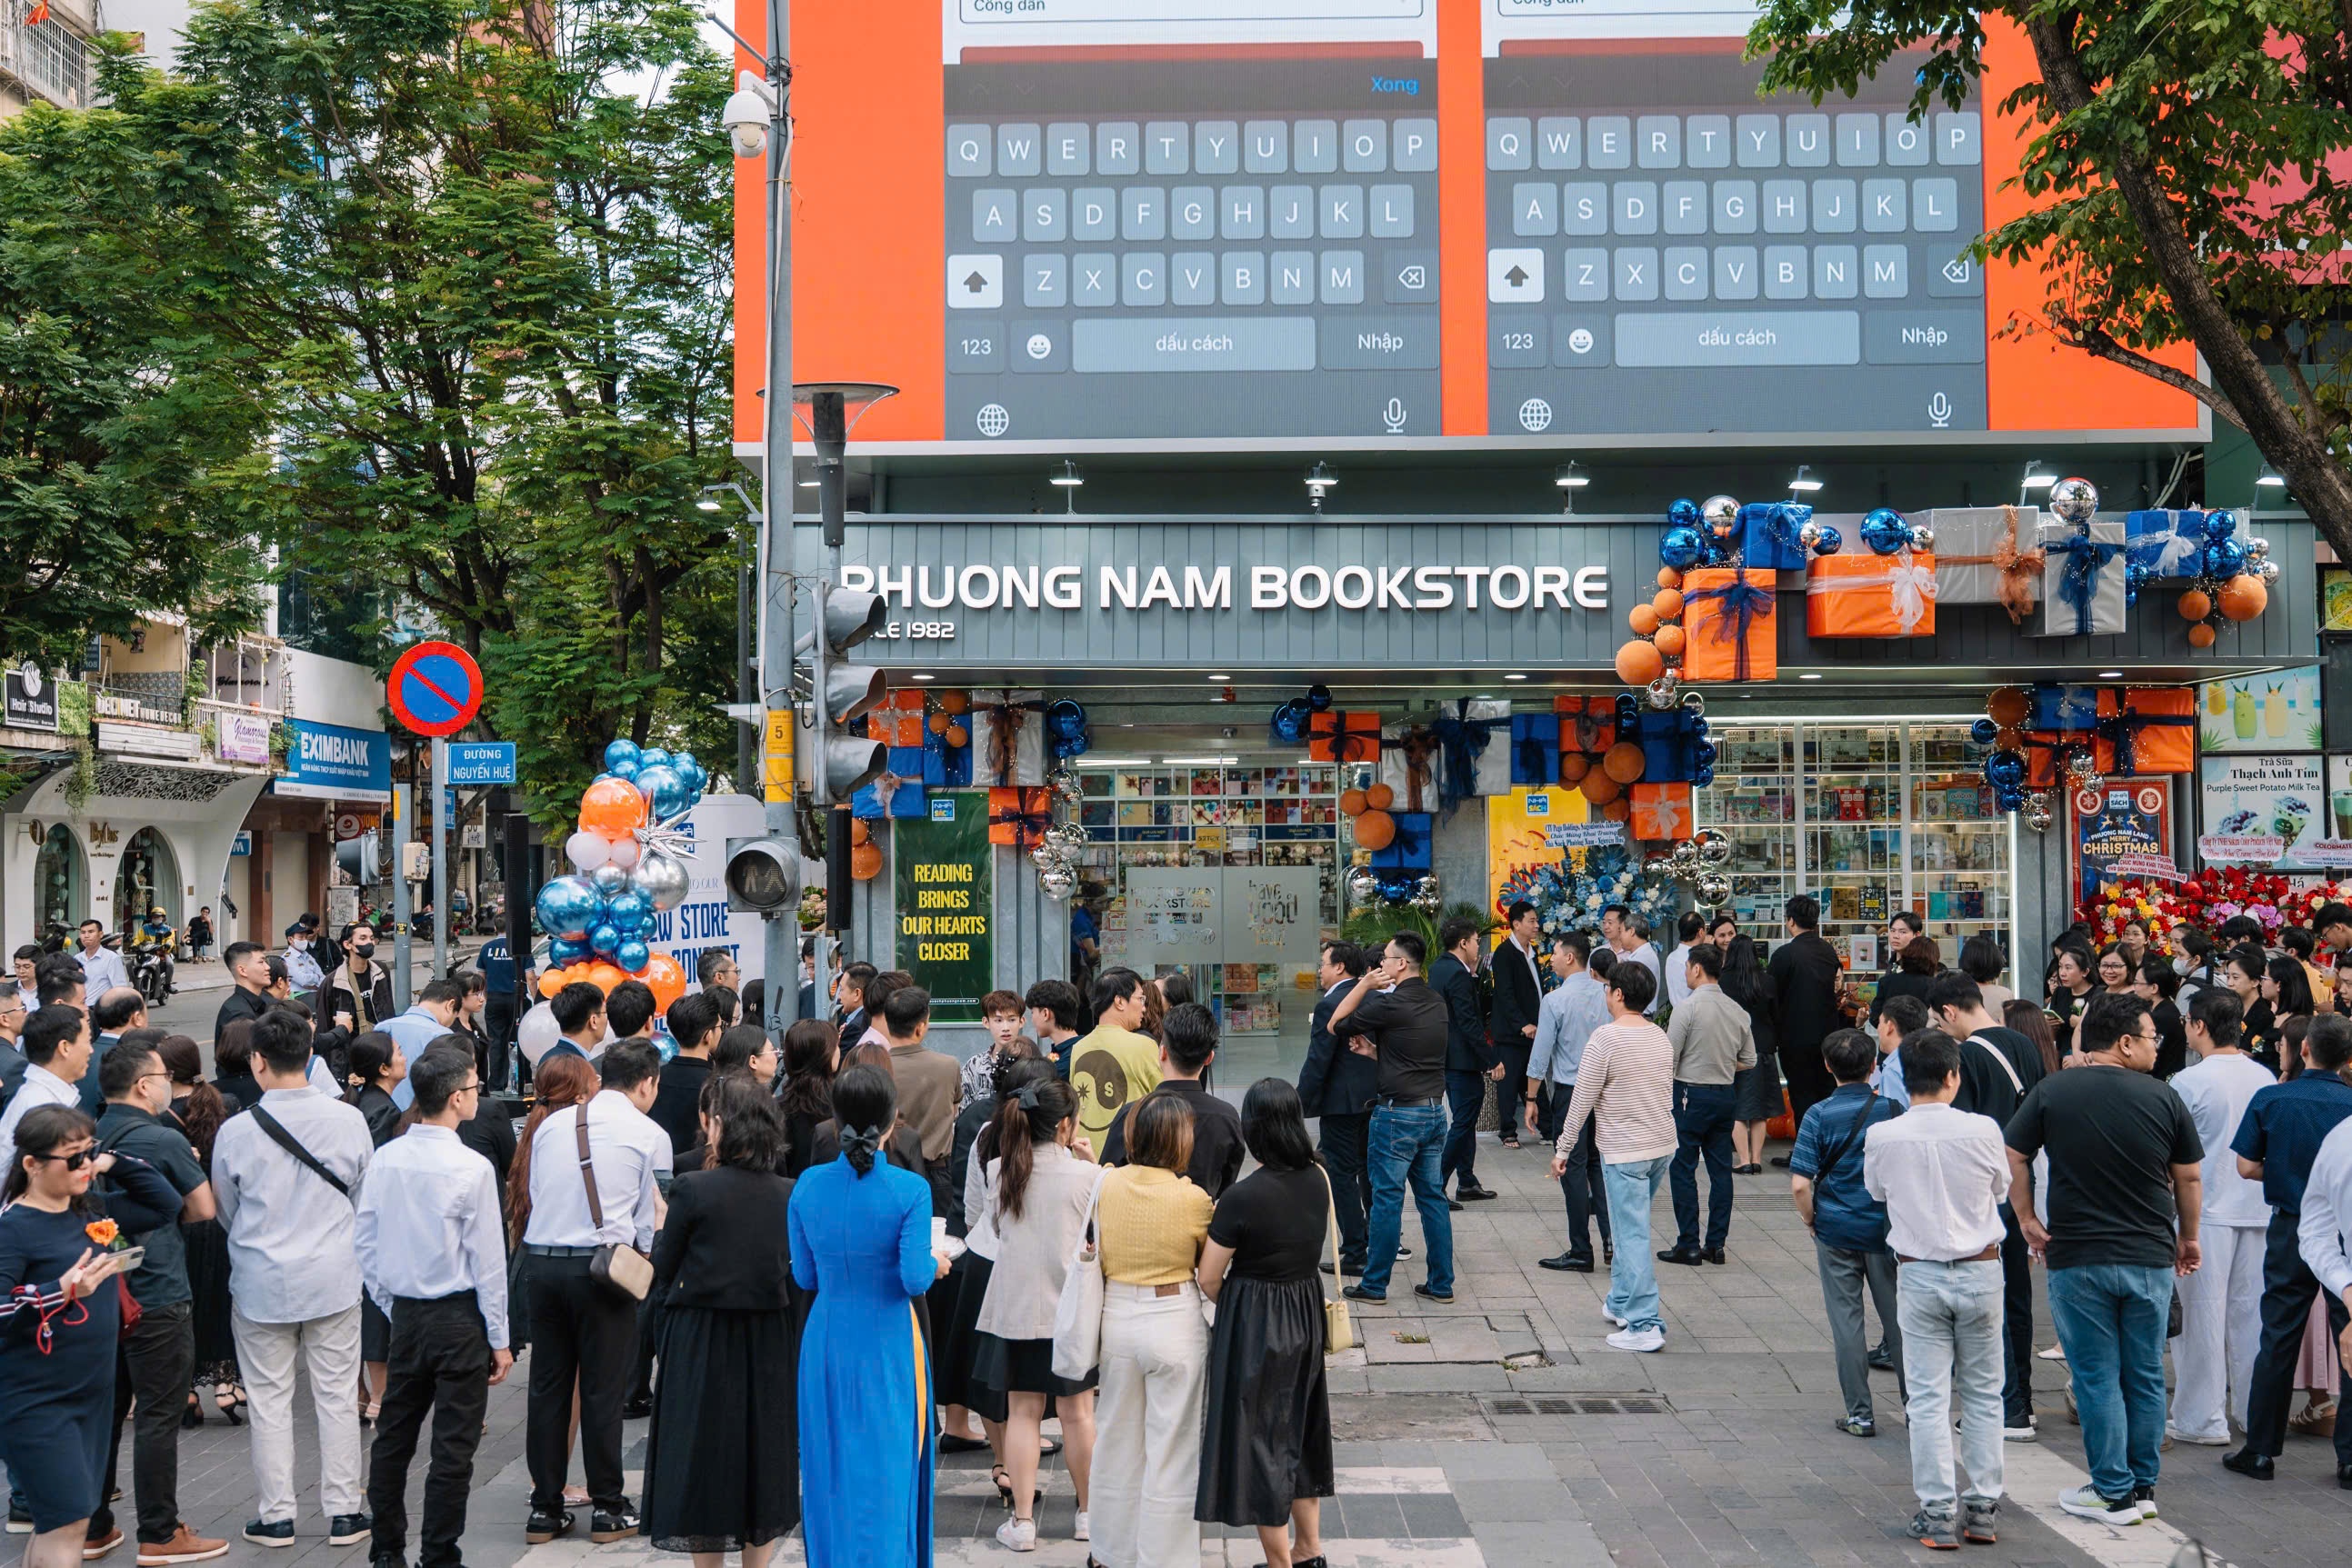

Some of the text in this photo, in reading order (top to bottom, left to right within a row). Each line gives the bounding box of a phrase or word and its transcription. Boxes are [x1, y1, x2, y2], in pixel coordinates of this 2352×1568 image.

[1371, 76, 1419, 95] Xong
[960, 135, 1423, 163] Q W E R T Y U I O P
[1499, 128, 1966, 155] Q W E R T Y U I O P
[986, 201, 1398, 226] A S D F G H J K L
[1526, 195, 1942, 220] A S D F G H J K L
[1037, 267, 1351, 291] Z X C V B N M
[1578, 261, 1896, 285] Z X C V B N M
[1156, 333, 1233, 352] dấu cách
[1357, 333, 1404, 354] Nhập
[1503, 334, 1534, 350] 123
[1698, 327, 1776, 346] dấu cách
[1902, 327, 1948, 347] Nhập
[961, 339, 992, 355] 123
[841, 564, 1608, 610] PHUONG NAM BOOKSTORE
[906, 622, 955, 639] 1982
[10, 697, 53, 715] Hair Studio
[775, 725, 783, 739] 5
[300, 731, 369, 766] EXIMBANK
[464, 748, 502, 760] ĐƯỜNG
[494, 763, 511, 781] HUỆ
[2230, 767, 2318, 781] Thạch Anh Tím
[2207, 784, 2232, 794] Purple
[2233, 784, 2258, 792] Sweet
[2260, 784, 2287, 792] Potato
[2288, 783, 2304, 791] Milk
[2133, 831, 2149, 840] LAND
[2082, 842, 2159, 854] CHRISTMAS
[915, 864, 973, 883] READING
[918, 890, 969, 909] BRINGS
[681, 902, 730, 940] STORE
[902, 915, 986, 935] OUR HEARTS
[918, 942, 970, 961] CLOSER
[1104, 1081, 1114, 1097] S
